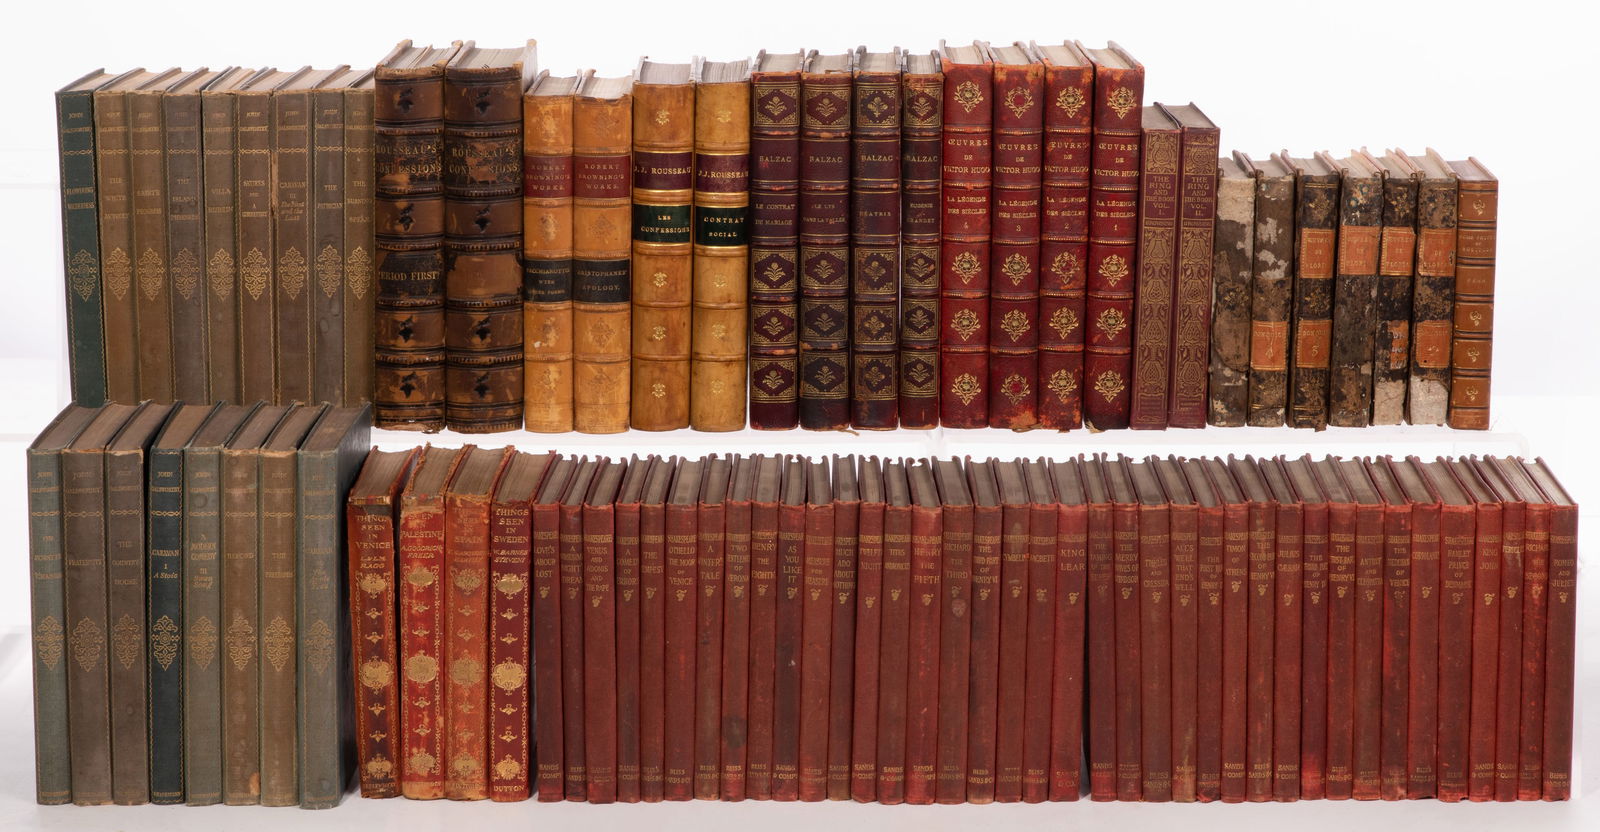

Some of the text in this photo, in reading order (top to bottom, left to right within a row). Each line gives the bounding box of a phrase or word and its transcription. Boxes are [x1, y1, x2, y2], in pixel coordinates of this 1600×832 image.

[999, 143, 1038, 151] ŒUVRES
[1099, 143, 1138, 151] ŒUVRES
[861, 154, 893, 162] BALZAC
[651, 166, 692, 175] ROUSSEAU
[943, 165, 990, 174] VICTOR HUGO
[1094, 169, 1120, 177] VICTOR
[496, 508, 529, 516] THINGS
[493, 535, 529, 543] SWEDEN
[355, 541, 391, 549] VENICE
[788, 545, 797, 553] AS
[1061, 549, 1085, 557] KING
[785, 555, 800, 563] YOU
[783, 566, 802, 574] LIKE
[1061, 563, 1085, 571] LEAR
[788, 575, 796, 583] IT
